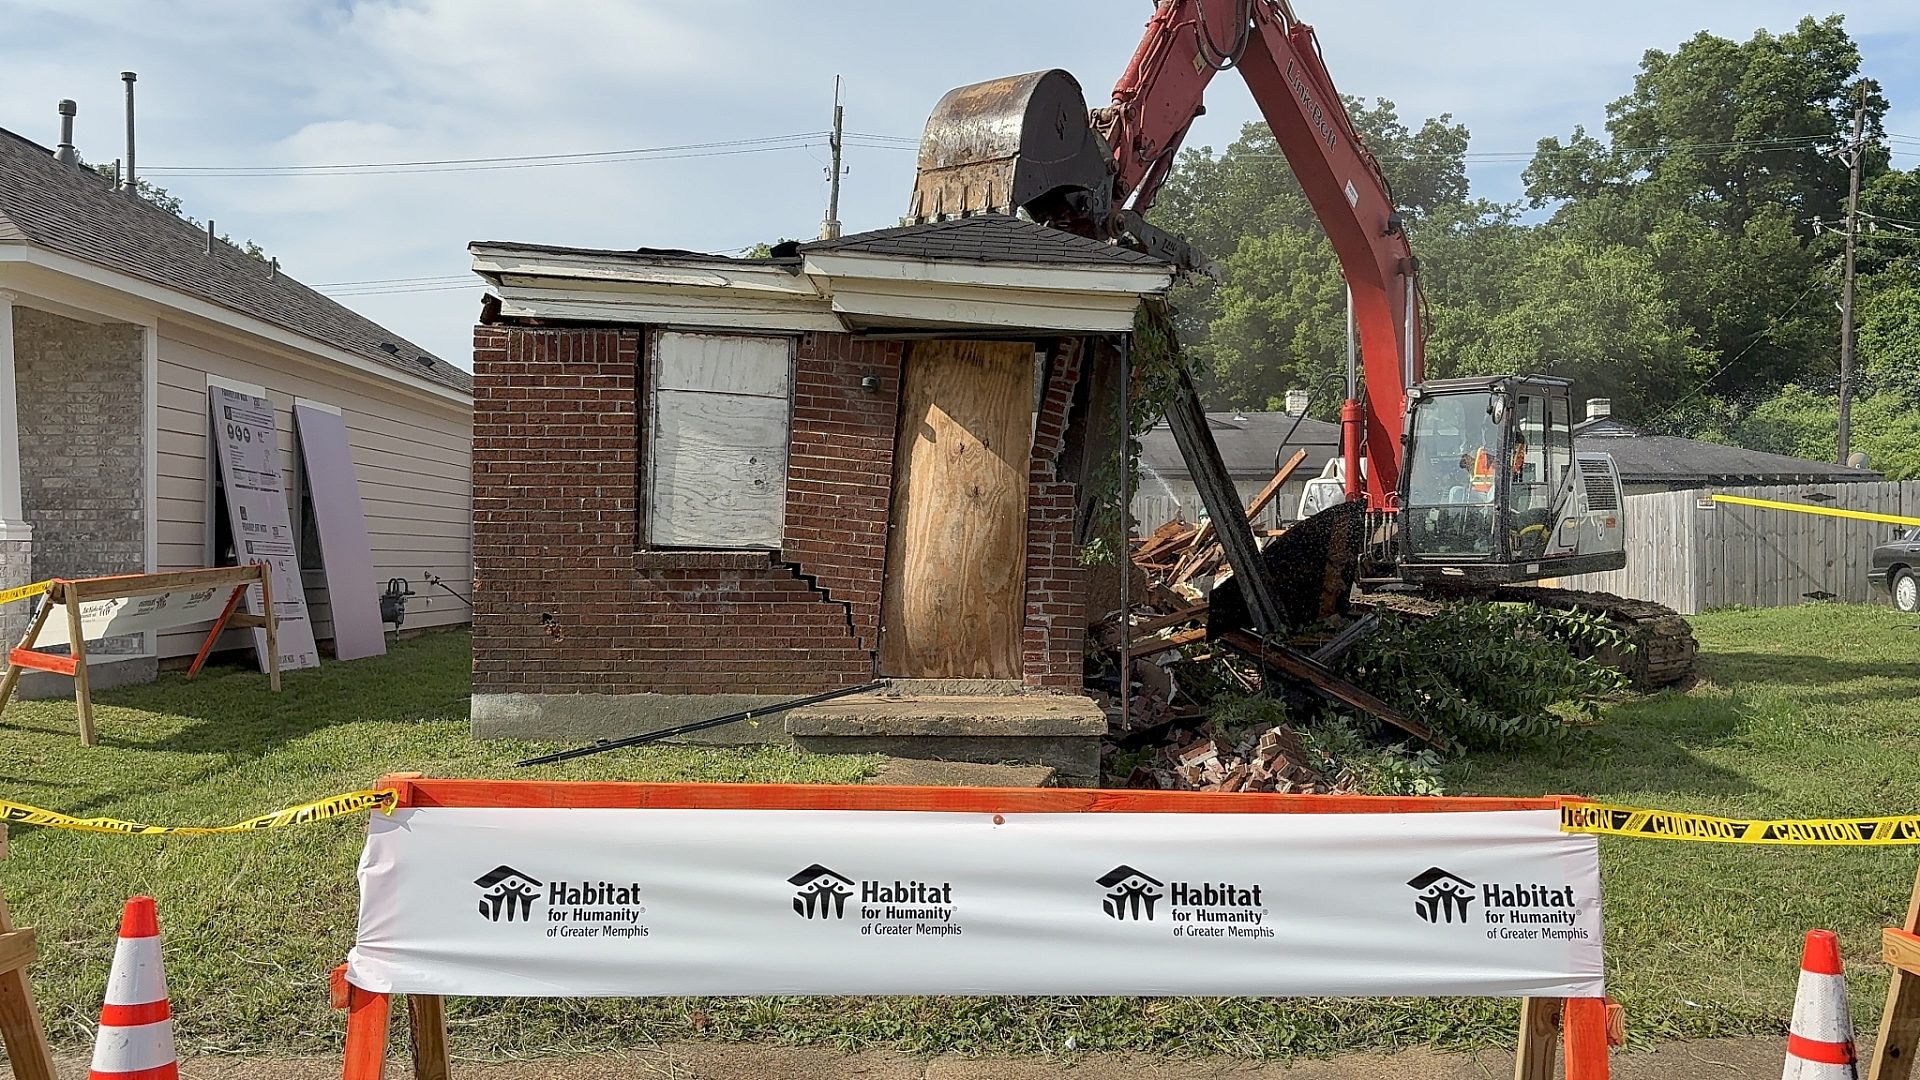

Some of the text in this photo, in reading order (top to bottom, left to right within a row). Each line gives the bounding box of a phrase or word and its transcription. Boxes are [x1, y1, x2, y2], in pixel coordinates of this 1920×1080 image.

[1652, 814, 1736, 839] CUIDADO
[1771, 821, 1864, 841] CAUTION
[549, 882, 641, 905] Habitat
[862, 881, 952, 903] Habitat
[1171, 883, 1262, 906] Habitat
[1483, 884, 1576, 907] Habitat
[548, 908, 568, 921] for
[861, 906, 882, 919] for
[1172, 909, 1192, 921] for
[1486, 910, 1505, 923] for
[547, 925, 649, 939] of Greater Memphis
[861, 923, 962, 937] of Greater Memphis
[1173, 925, 1275, 939] of Greater Memphis
[1487, 928, 1589, 941] of Greater Memphis
